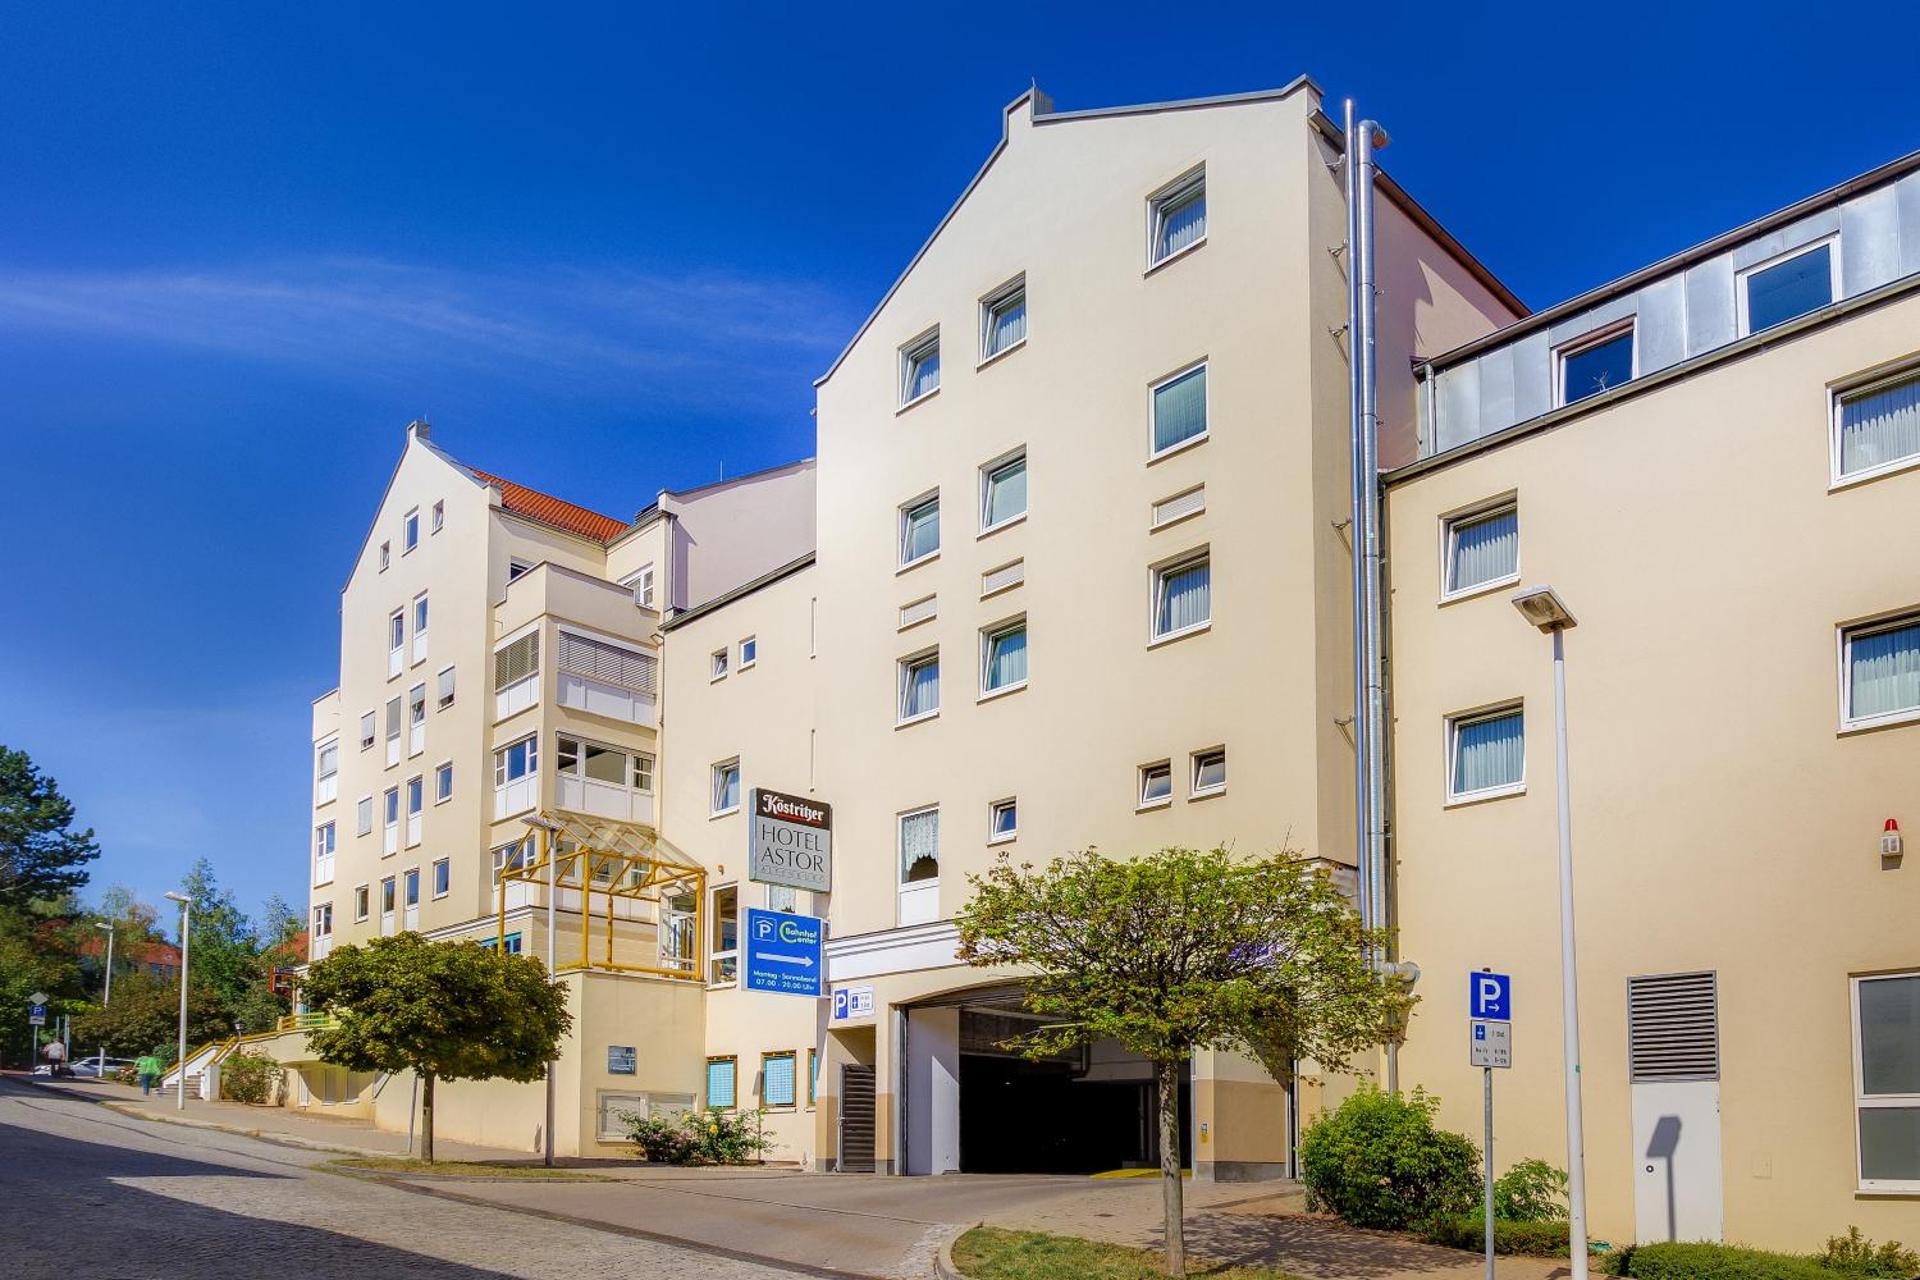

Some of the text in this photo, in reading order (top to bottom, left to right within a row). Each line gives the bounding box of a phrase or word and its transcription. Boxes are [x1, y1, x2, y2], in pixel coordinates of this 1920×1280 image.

[762, 794, 824, 821] Köstritzer
[762, 823, 823, 852] HOTEL
[761, 846, 824, 873] ASTOR
[760, 923, 771, 938] P
[753, 970, 778, 980] Montag
[836, 993, 846, 1018] P
[1480, 978, 1500, 1013] P
